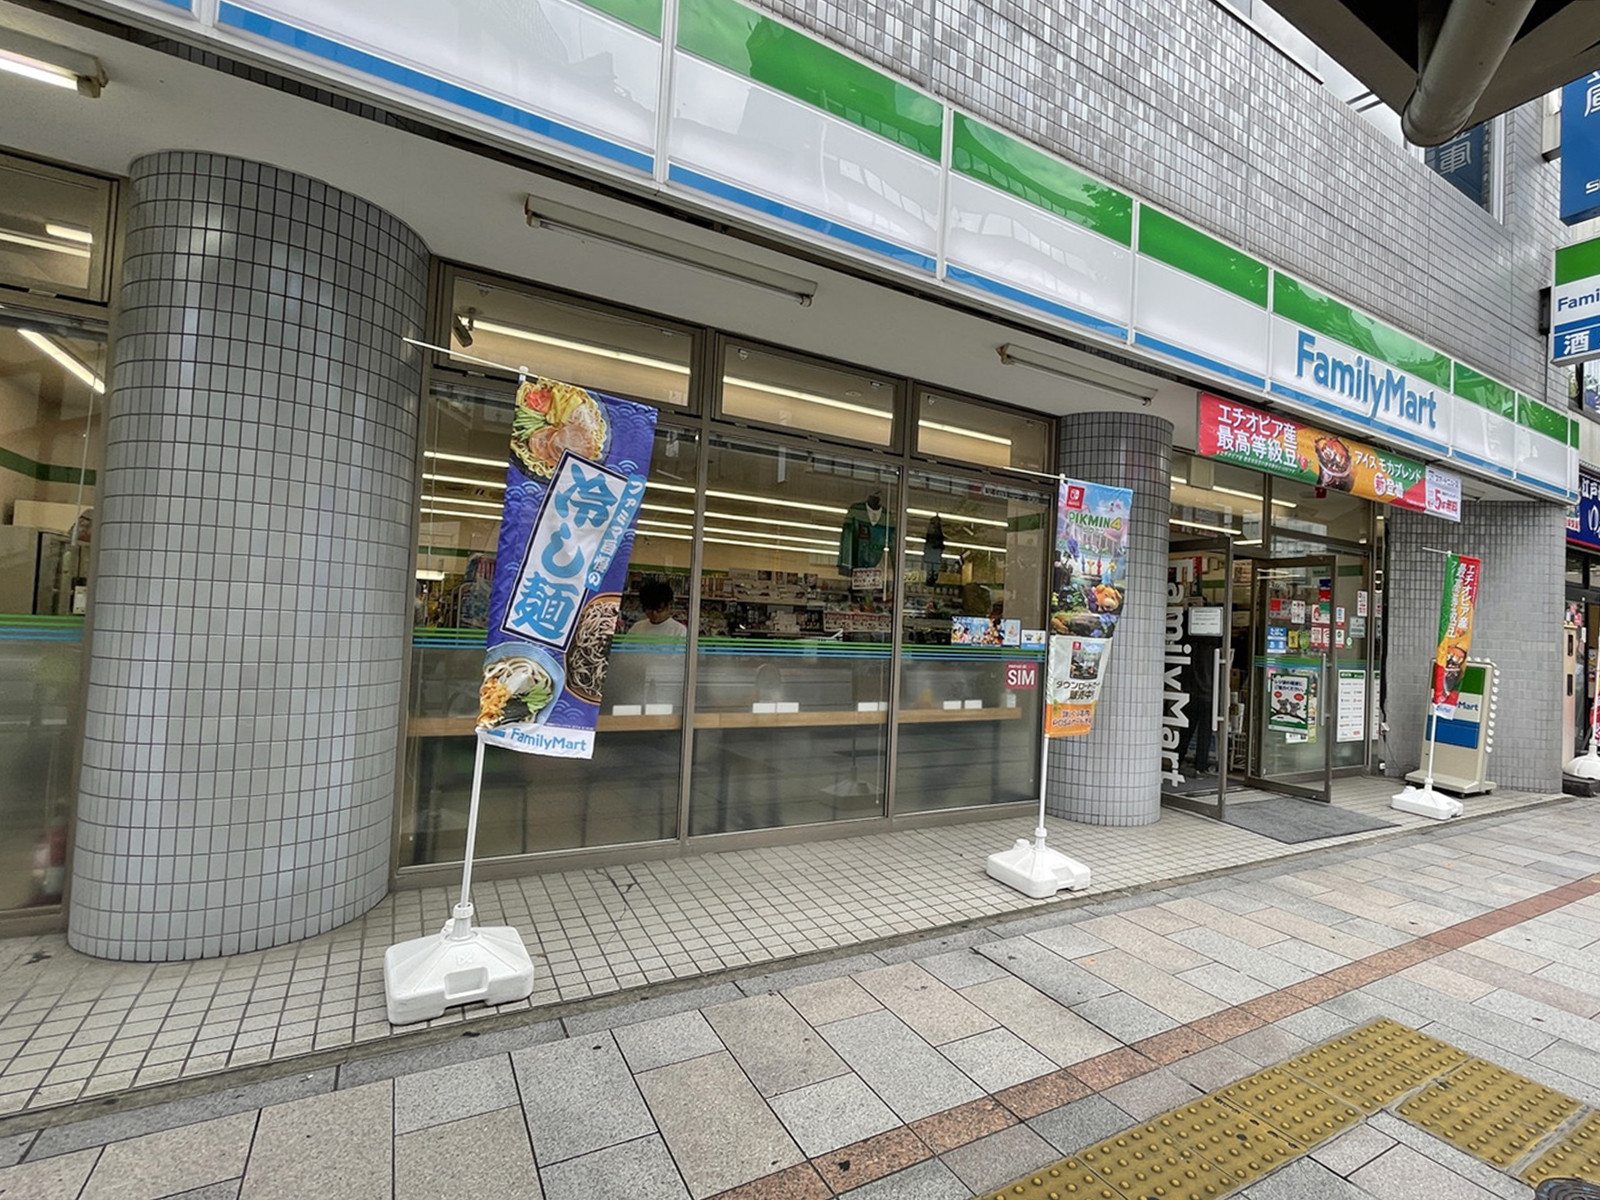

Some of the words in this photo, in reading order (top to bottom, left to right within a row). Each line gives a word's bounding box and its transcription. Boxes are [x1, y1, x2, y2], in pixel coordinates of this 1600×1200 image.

[1563, 330, 1590, 355] 酒
[1296, 330, 1437, 429] FamilyMart
[1218, 404, 1297, 445] エチオピア産
[1217, 424, 1298, 468] 最高等級豆
[588, 481, 643, 586] ファミマ自慢の
[1069, 511, 1110, 528] PIKMIN
[1111, 517, 1122, 531] 4
[511, 462, 619, 640] 冷し麺
[1008, 670, 1035, 685] SIM
[510, 728, 586, 751] FamilyMart
